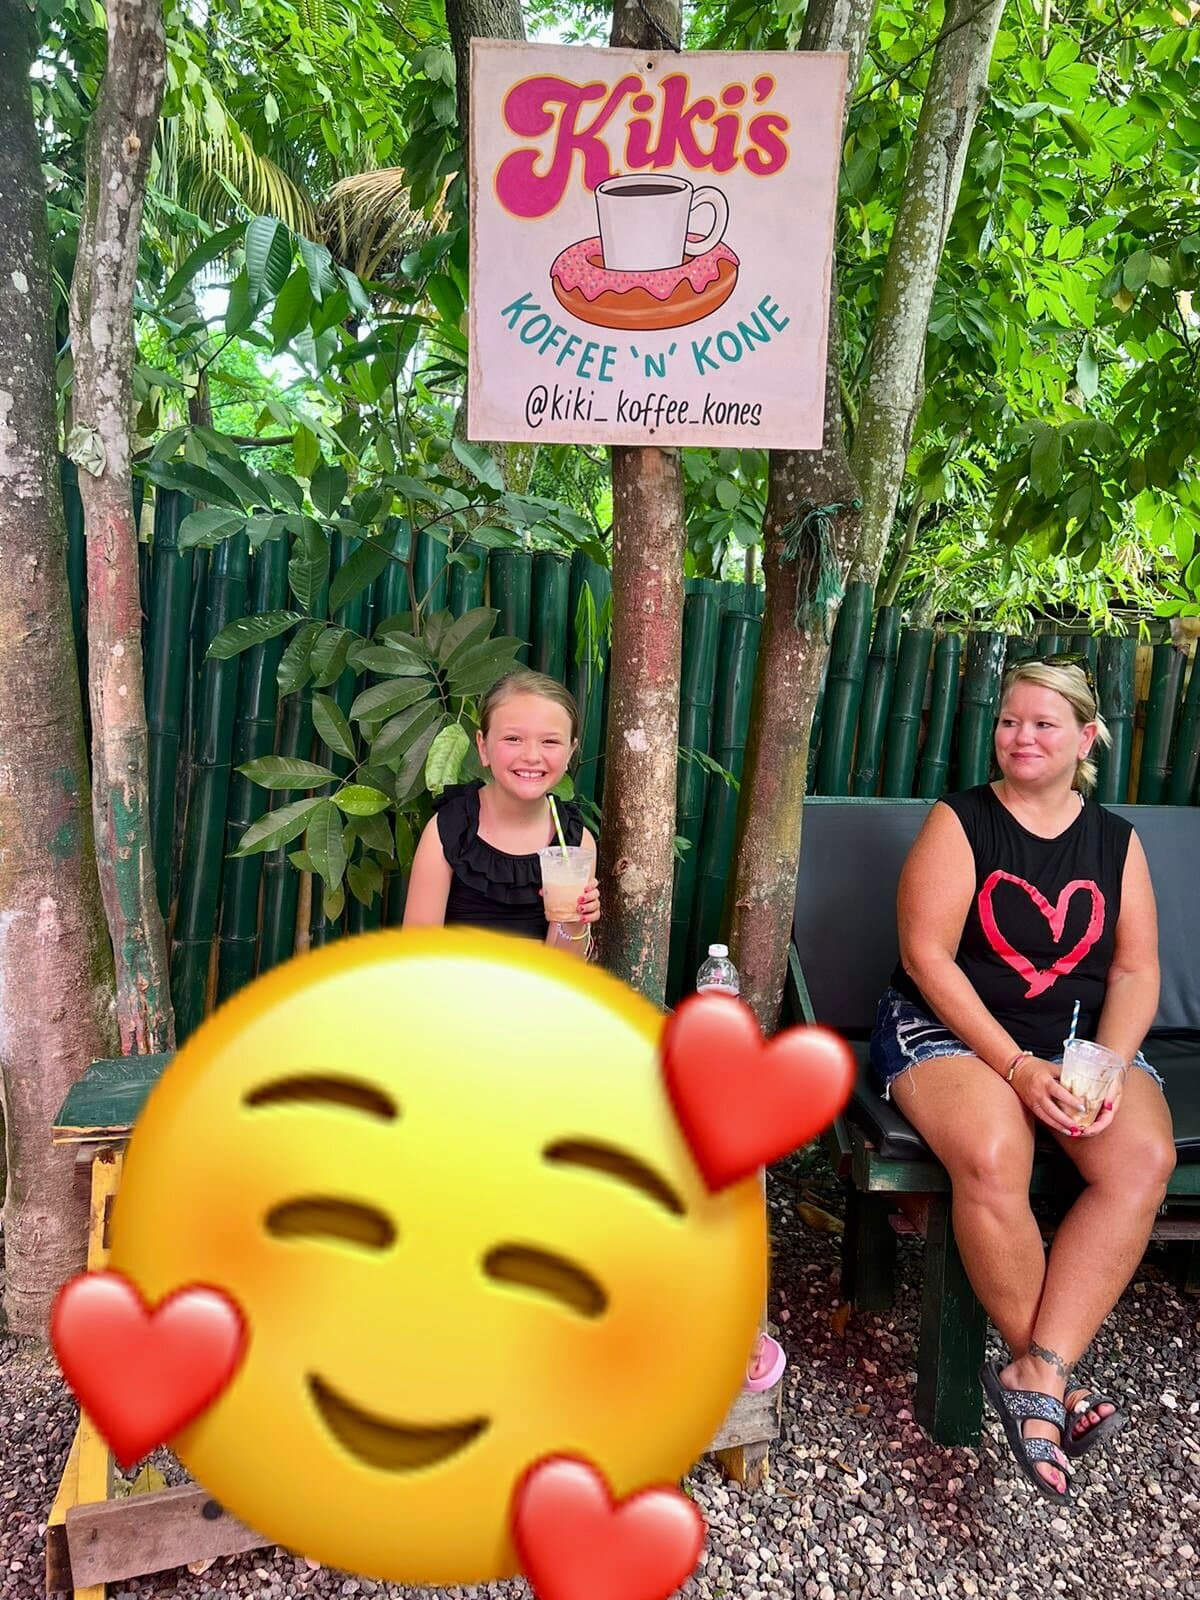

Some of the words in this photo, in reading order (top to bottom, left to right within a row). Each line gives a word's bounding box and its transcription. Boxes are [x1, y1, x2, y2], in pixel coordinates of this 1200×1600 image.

[493, 72, 792, 220] Kiki's
[500, 292, 617, 383] KOFFEE
[691, 294, 790, 375] KONE
